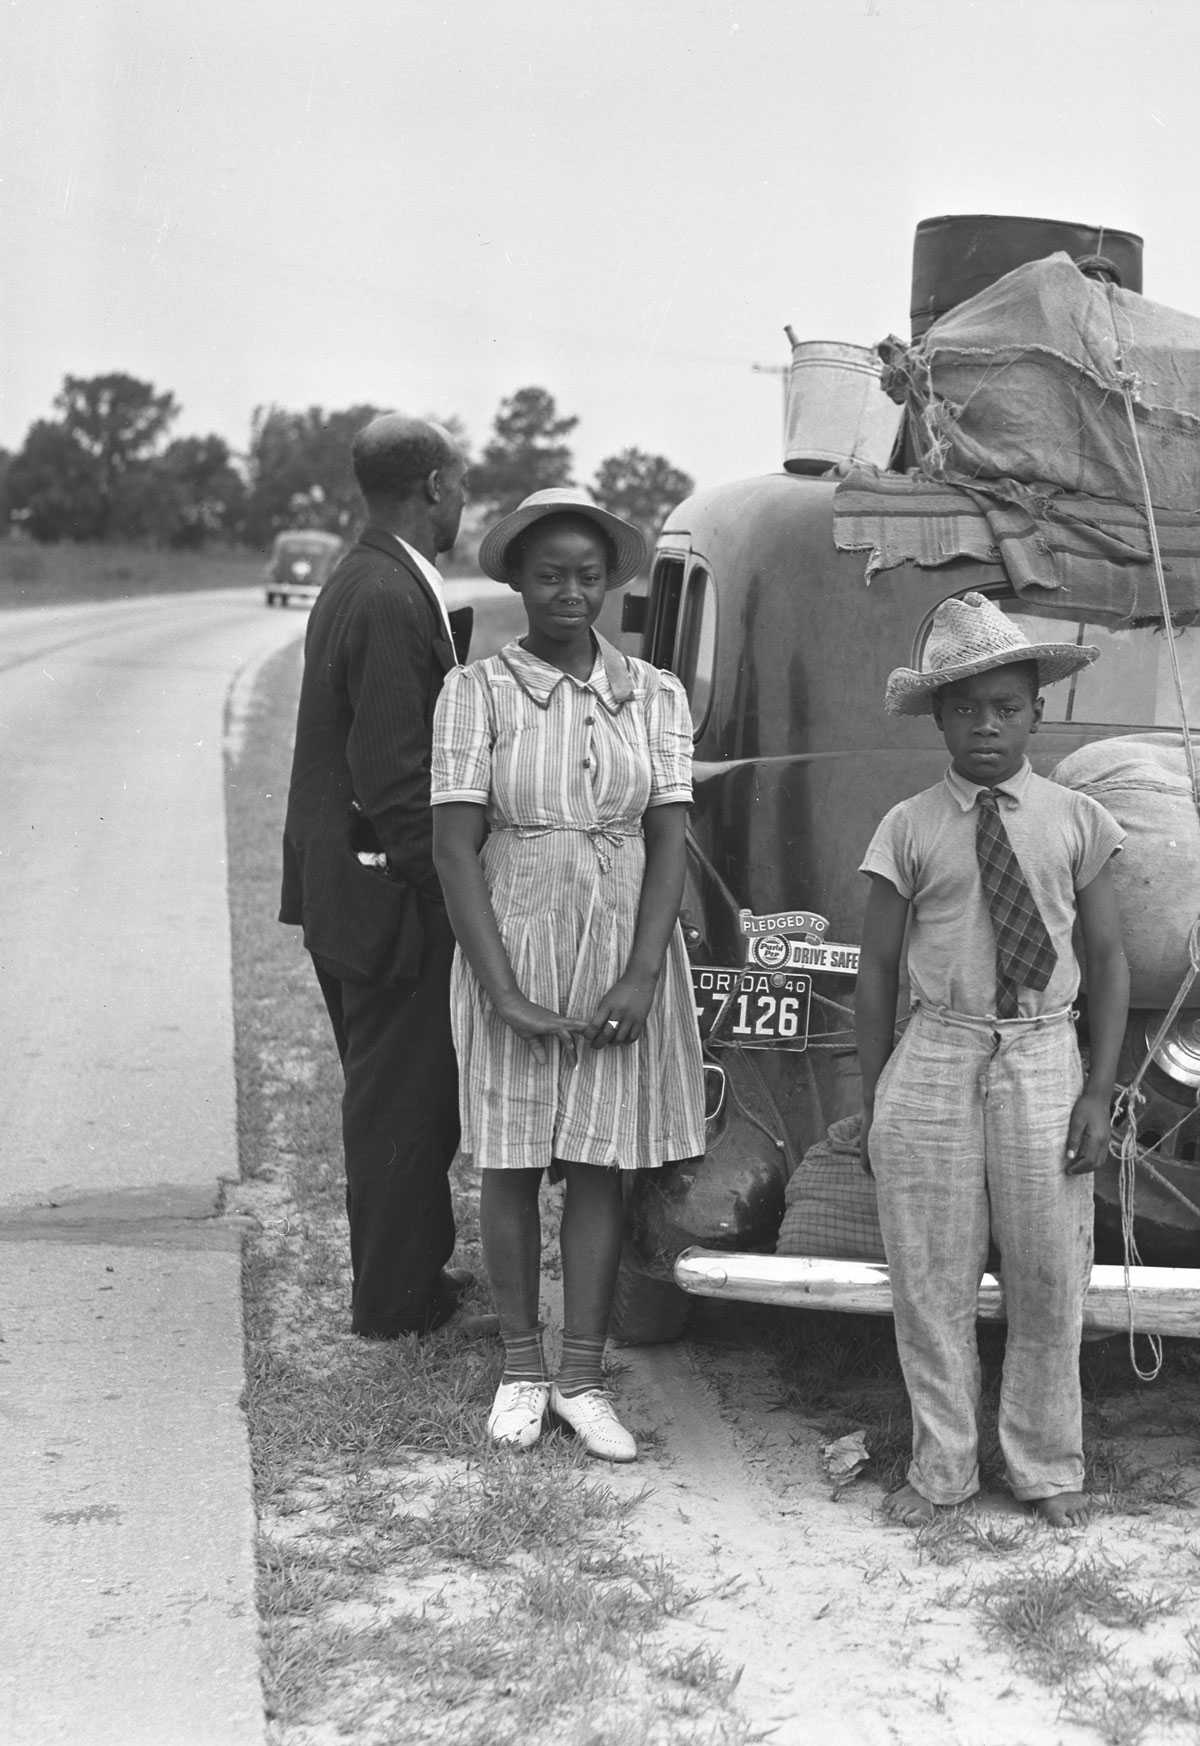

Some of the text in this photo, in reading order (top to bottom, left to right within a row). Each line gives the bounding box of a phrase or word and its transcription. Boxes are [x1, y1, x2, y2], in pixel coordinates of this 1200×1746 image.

[743, 916, 825, 933] PLEDGED TO
[793, 946, 827, 966] DRIVE
[694, 973, 806, 993] ORIDA 40
